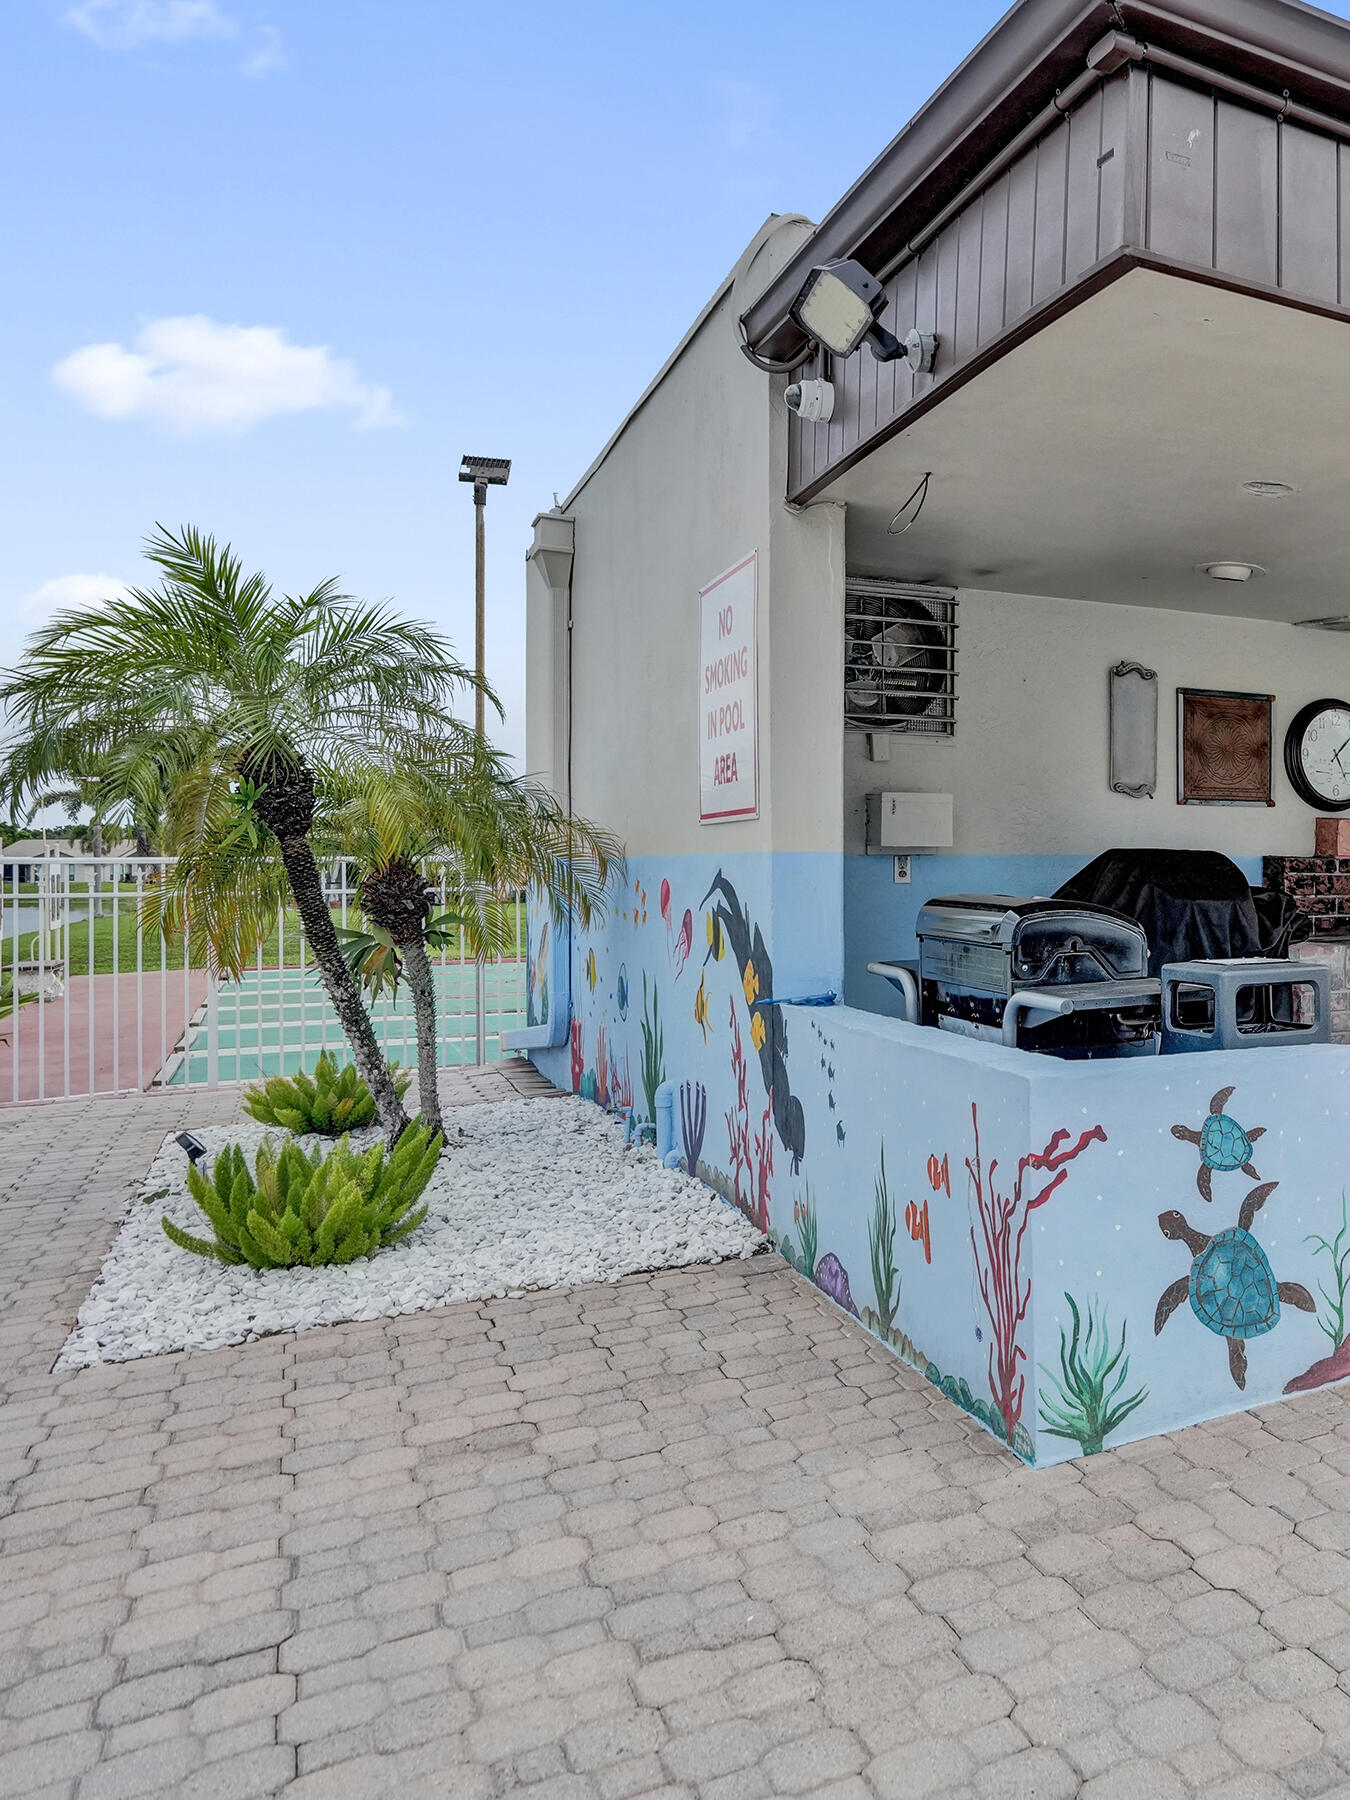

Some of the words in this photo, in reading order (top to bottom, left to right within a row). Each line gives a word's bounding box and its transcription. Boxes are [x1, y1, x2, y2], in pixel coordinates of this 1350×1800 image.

[719, 605, 733, 640] NO
[705, 646, 748, 694] SMOKING
[708, 709, 717, 740] IN
[720, 699, 745, 736] POOL
[1332, 712, 1341, 727] 12
[1307, 728, 1318, 742] 10
[1302, 747, 1309, 761] 9
[714, 752, 738, 786] AREA
[1332, 784, 1340, 797] 6
